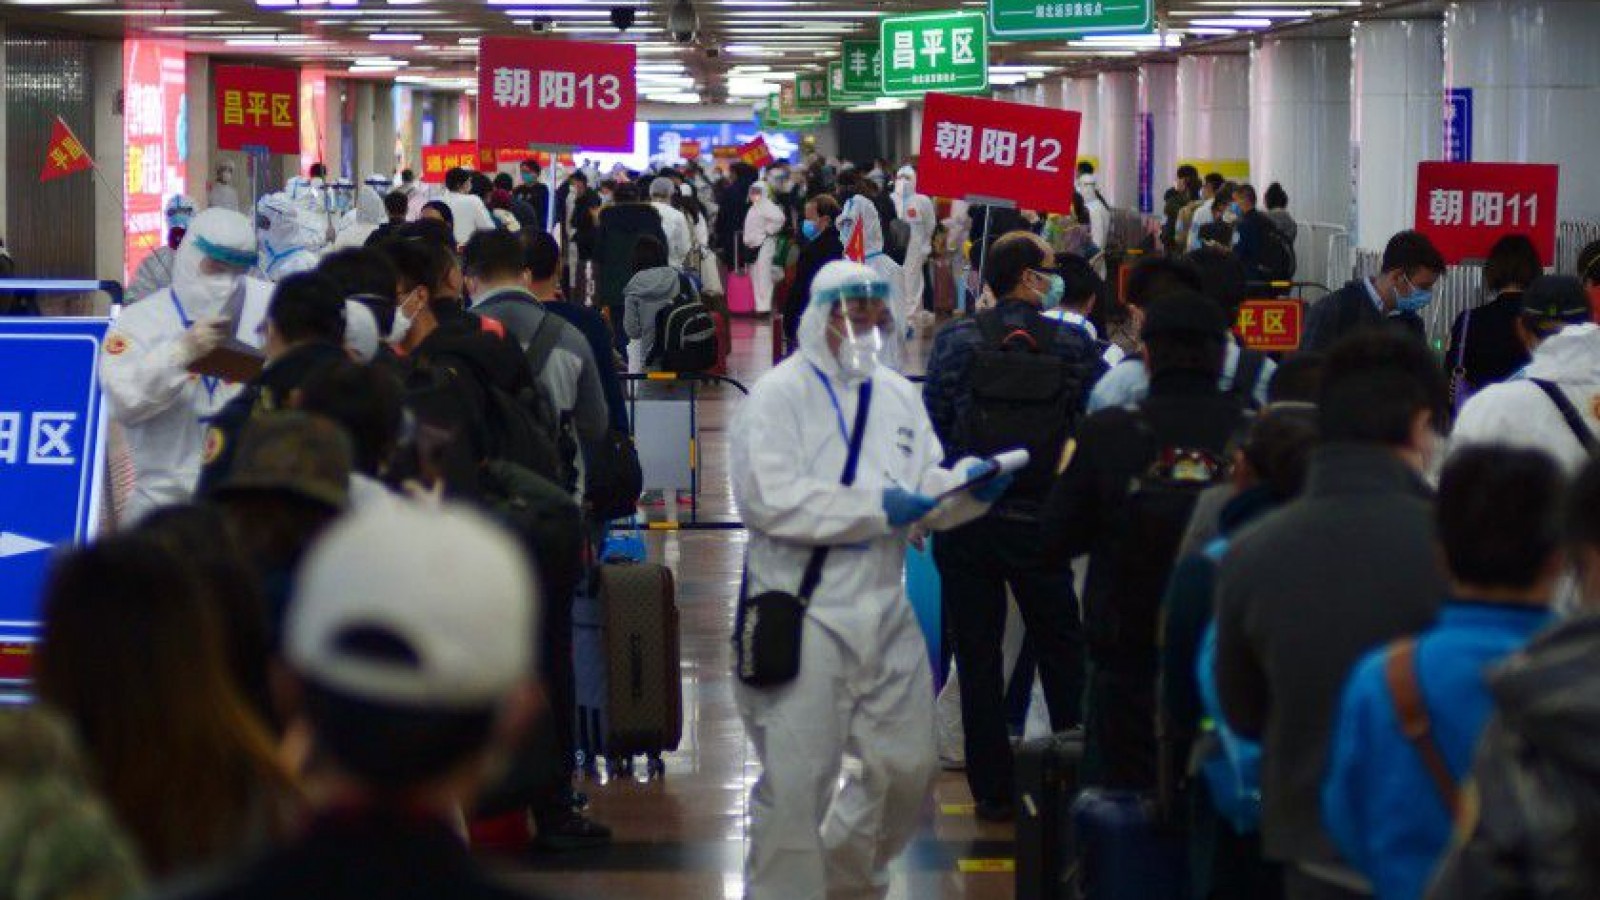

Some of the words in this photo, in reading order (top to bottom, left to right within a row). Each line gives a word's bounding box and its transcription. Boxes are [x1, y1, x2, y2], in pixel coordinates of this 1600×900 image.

[892, 28, 976, 70] 昌平区
[223, 89, 294, 127] 昌平区
[492, 66, 622, 110] 朝阳13
[933, 121, 1063, 173] 朝阳12
[1428, 188, 1538, 228] 朝阳11
